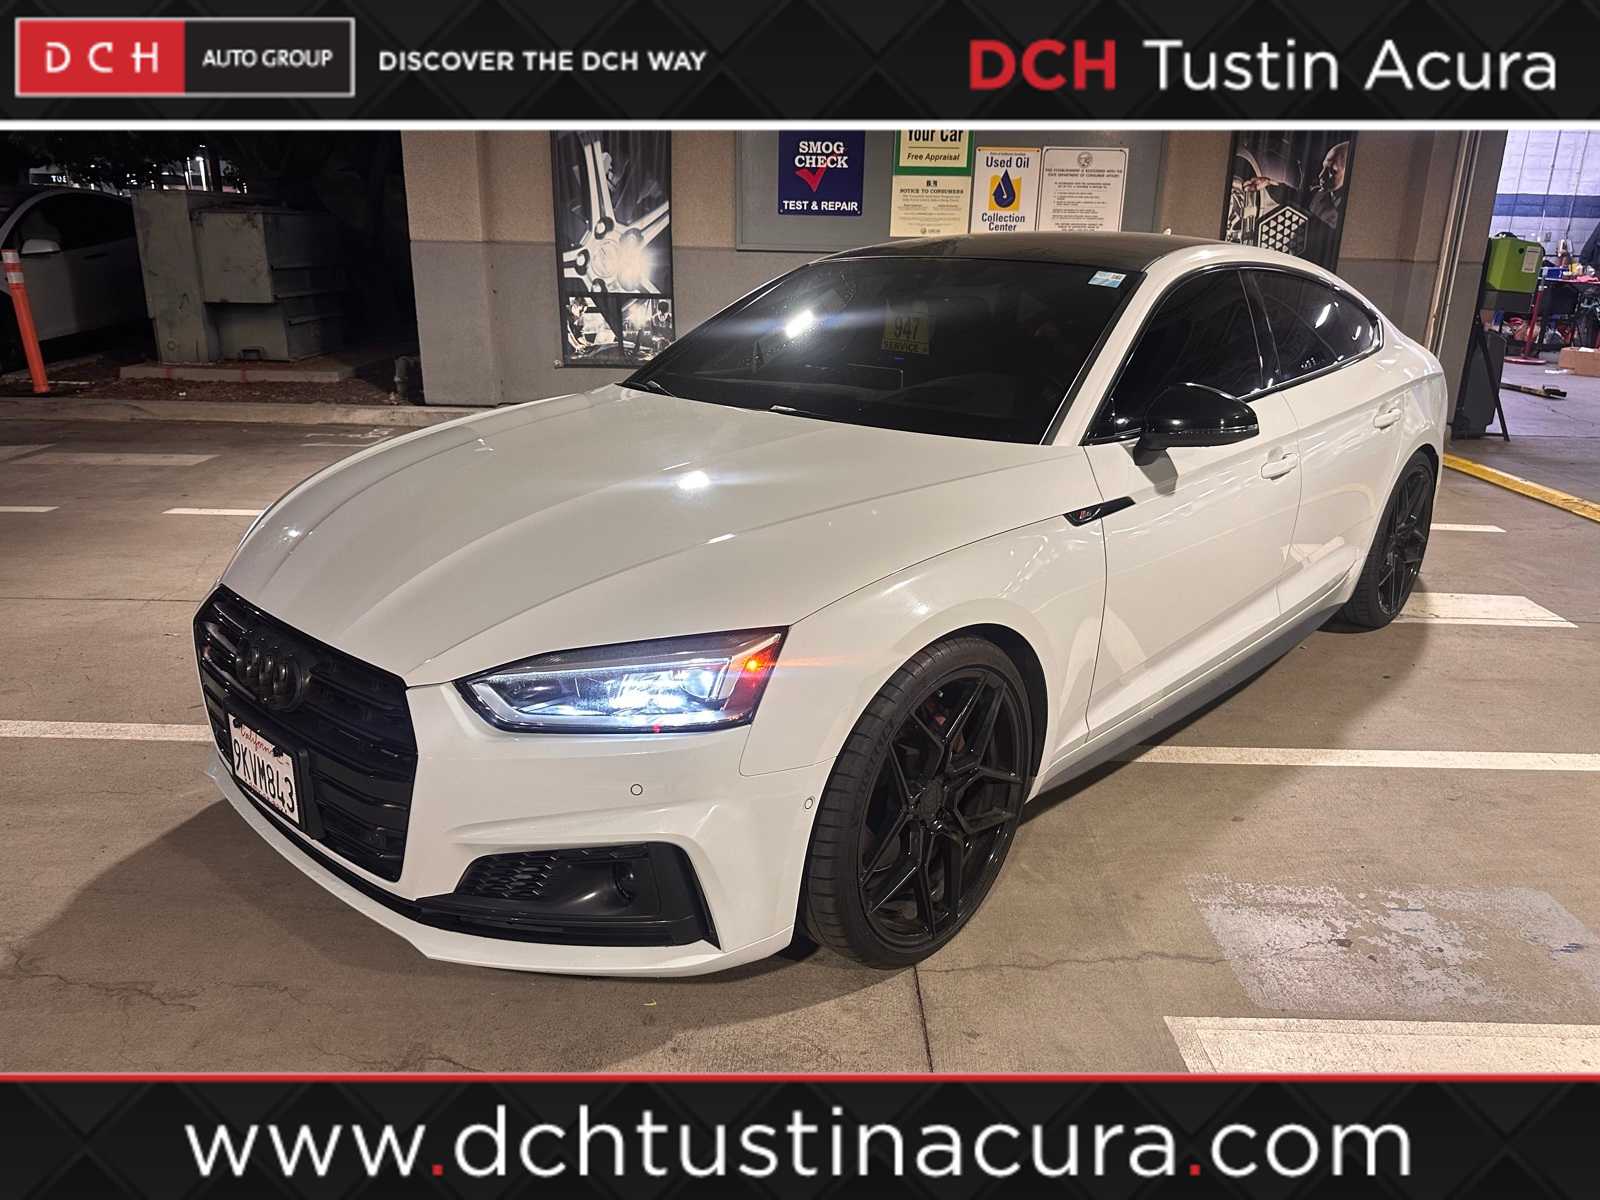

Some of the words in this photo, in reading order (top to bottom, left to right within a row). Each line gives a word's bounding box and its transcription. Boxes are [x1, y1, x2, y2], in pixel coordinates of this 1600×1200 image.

[799, 141, 845, 154] SMOG
[794, 155, 849, 168] CHECK
[906, 152, 924, 161] Free
[925, 153, 960, 162] Appraisal
[985, 156, 1013, 168] Used
[1015, 157, 1030, 169] Oil
[783, 200, 809, 211] TEST
[811, 200, 819, 211] &
[821, 201, 858, 212] REPAIR
[981, 213, 1026, 223] Collection
[988, 222, 1017, 232] Center
[233, 738, 295, 813] 9KVM843
